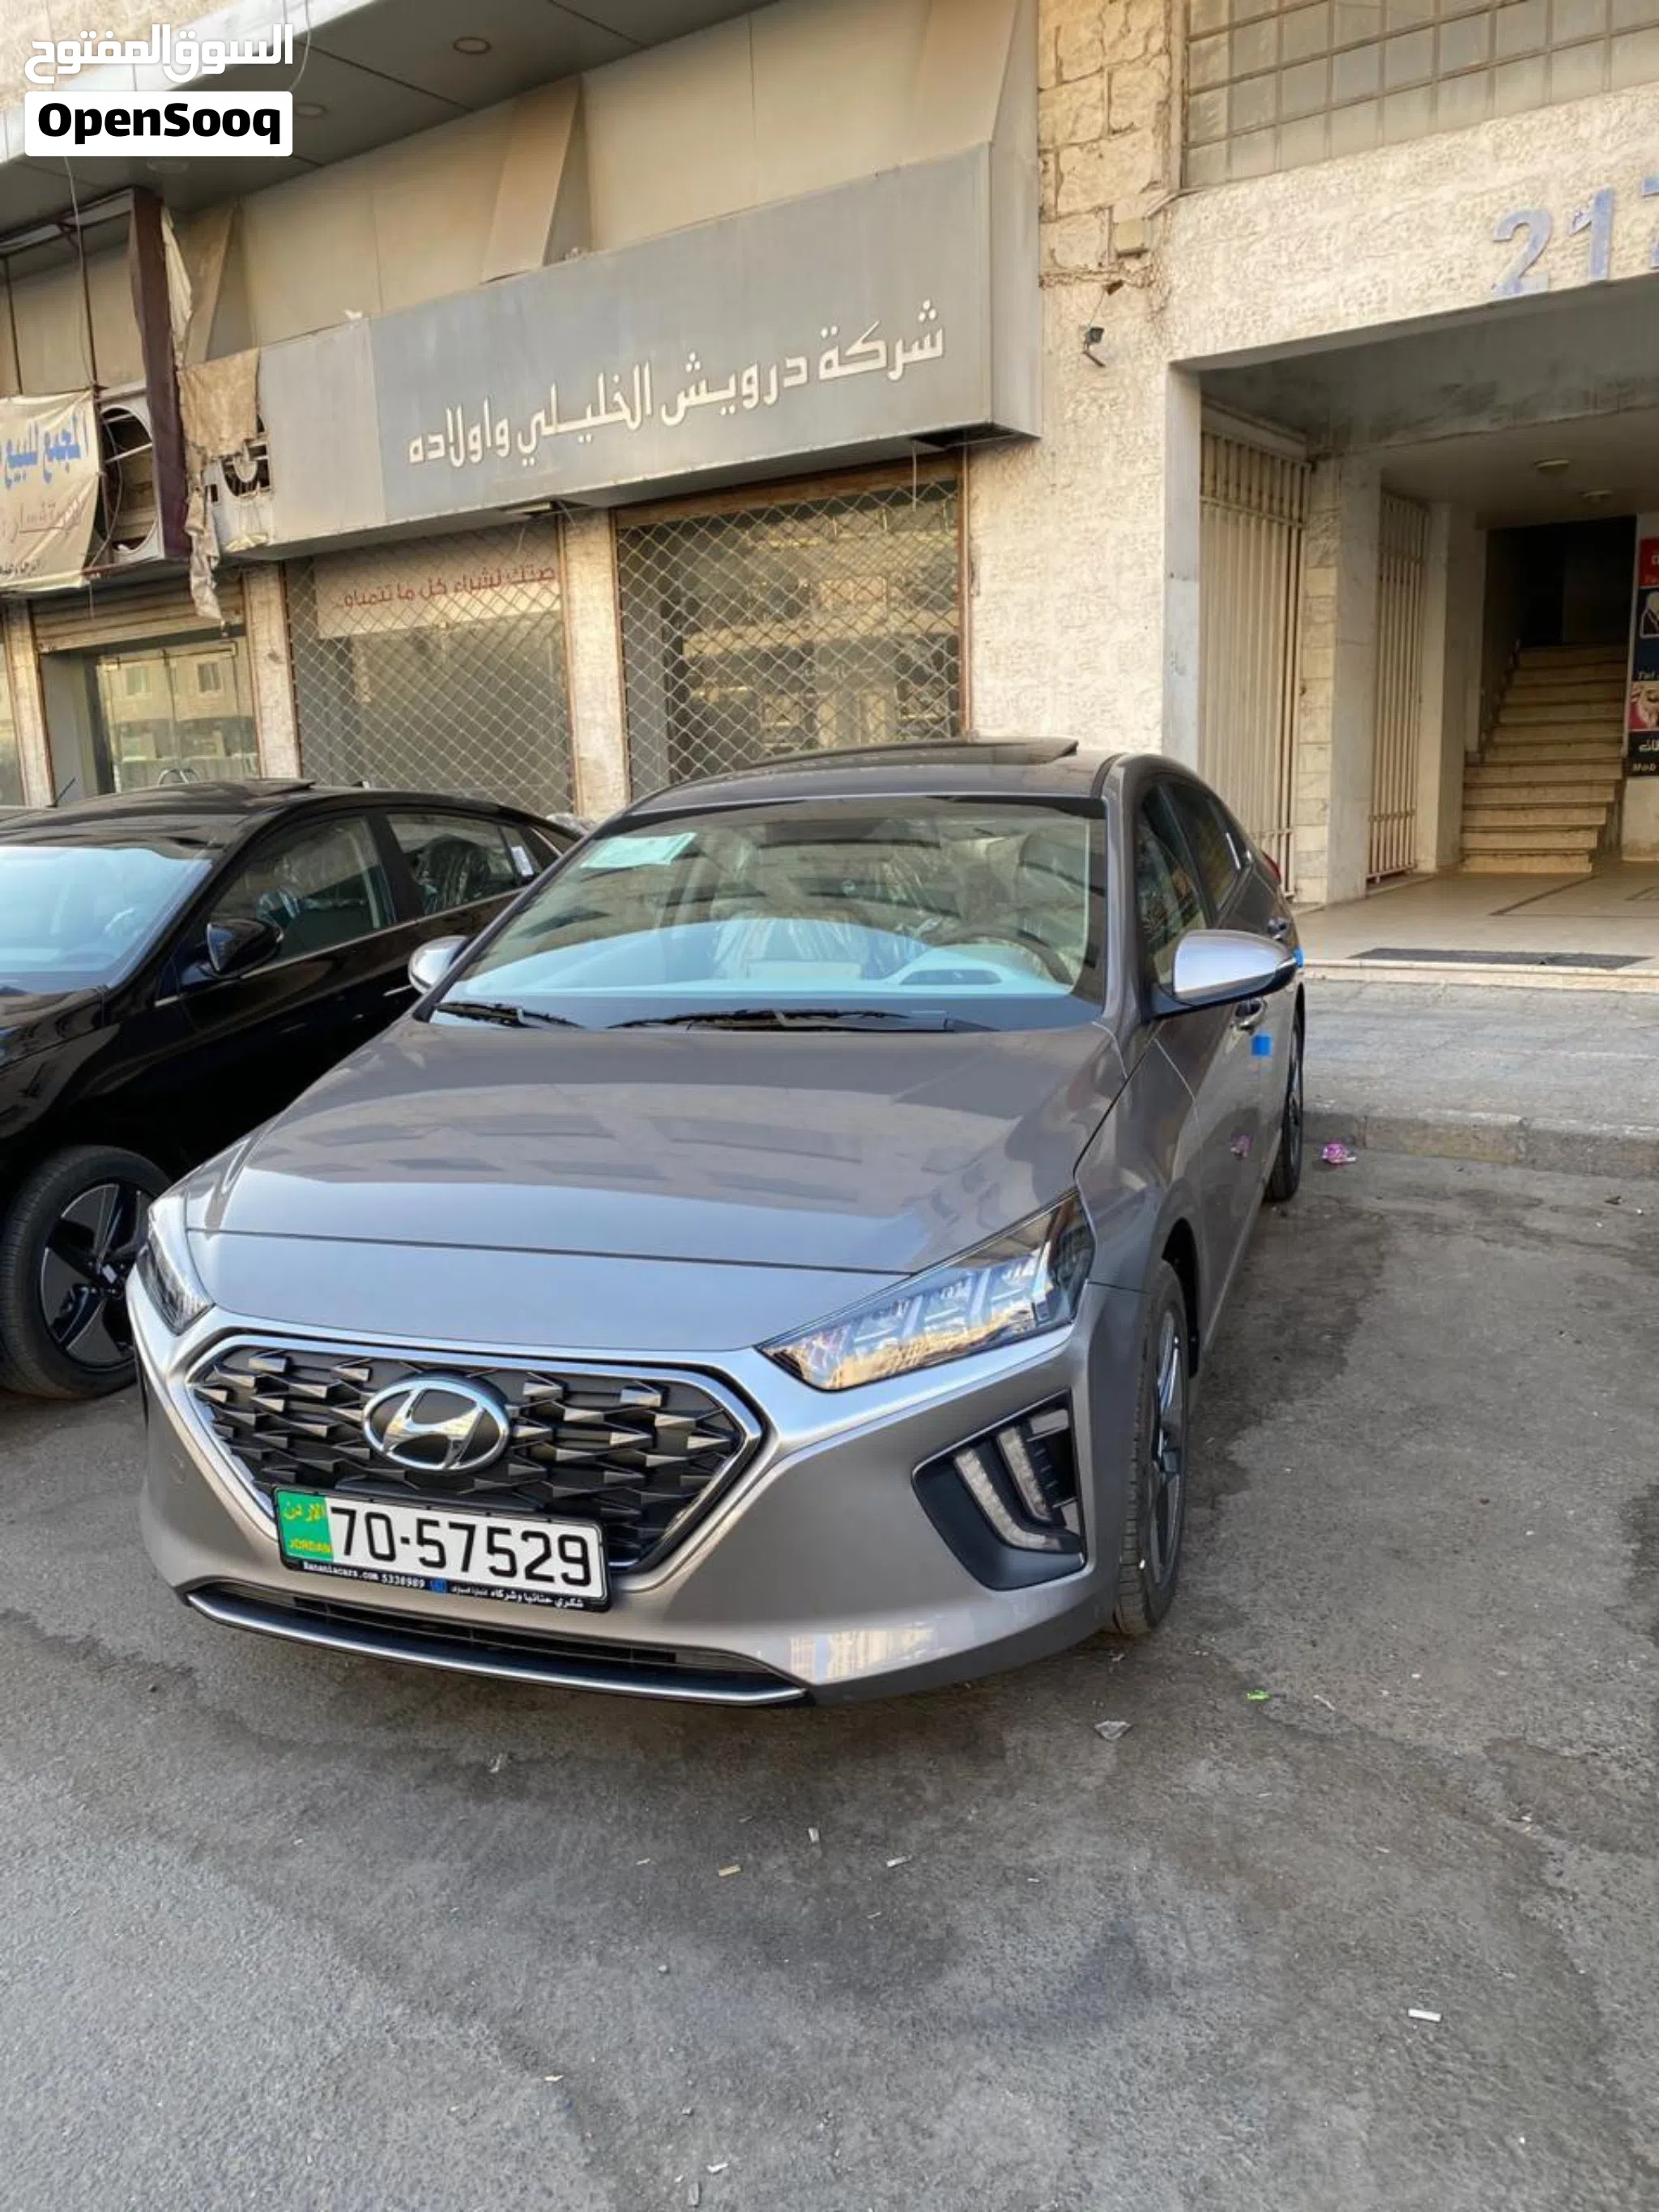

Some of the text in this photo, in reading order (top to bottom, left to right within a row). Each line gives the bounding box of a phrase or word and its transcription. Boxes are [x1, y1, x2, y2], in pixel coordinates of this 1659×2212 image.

[408, 300, 944, 468] شركة درويش الخليلي واولاده
[4, 420, 39, 489] للبيع
[397, 582, 416, 602] ما
[420, 576, 447, 599] كل
[331, 1507, 592, 1587] 70-57529
